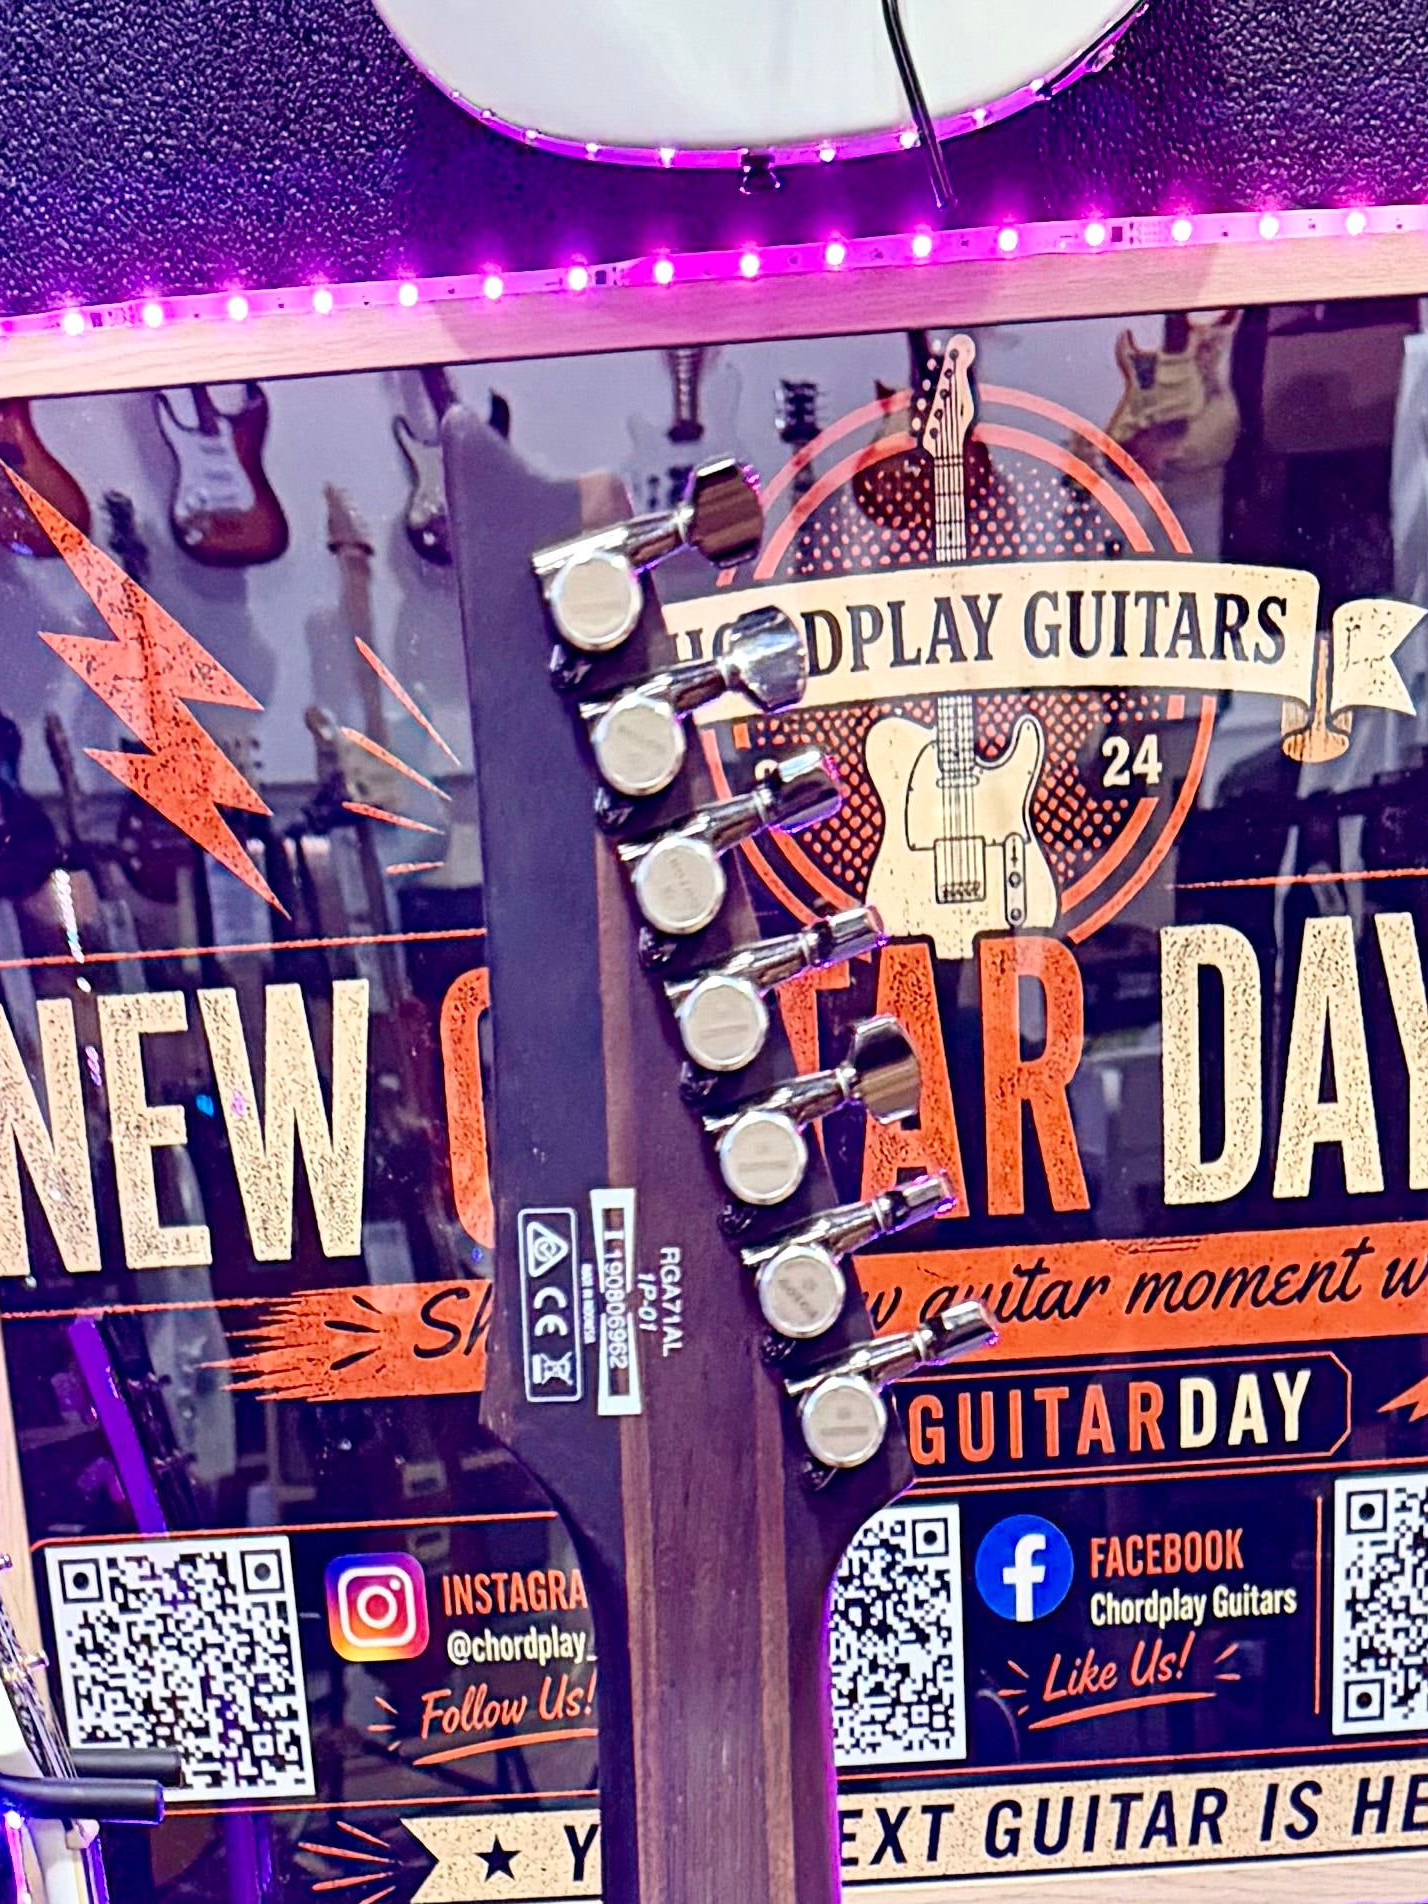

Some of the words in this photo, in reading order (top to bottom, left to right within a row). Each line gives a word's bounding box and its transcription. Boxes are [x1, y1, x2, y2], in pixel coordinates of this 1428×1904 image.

[1024, 589, 1289, 667] GUITARS
[1100, 735, 1163, 788] 24
[659, 1246, 685, 1358] RGA71AL
[1125, 1242, 1377, 1317] moment
[909, 1367, 1314, 1466] GUITARDAY
[1089, 1527, 1245, 1580] FACEBOOK
[441, 1568, 589, 1618] INSTAGRA
[1089, 1588, 1207, 1630] Chordplay
[1212, 1582, 1298, 1619] Guitars
[1042, 1647, 1119, 1702] Like
[1130, 1630, 1197, 1688] Us!
[419, 1682, 528, 1741] Follow
[538, 1667, 598, 1723] Us!
[840, 1804, 956, 1868] EXT
[984, 1786, 1230, 1860] GUITAR
[1260, 1779, 1323, 1842] IS
